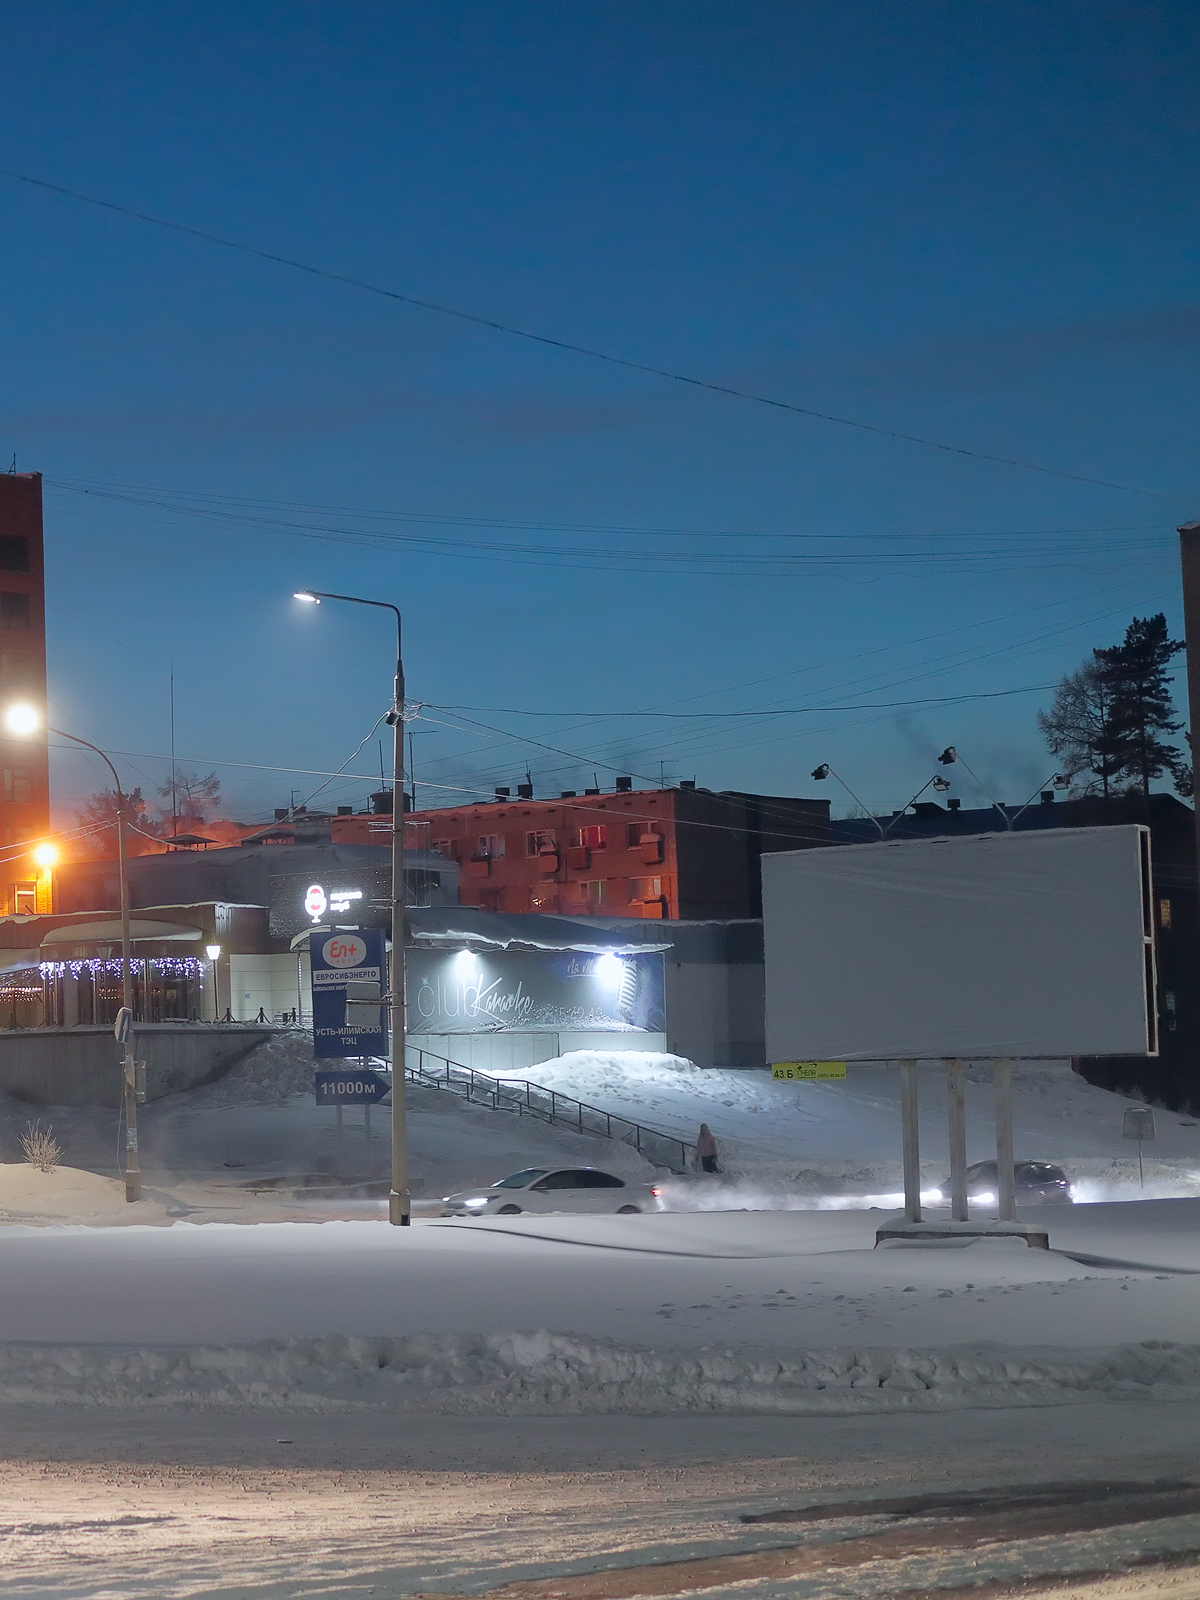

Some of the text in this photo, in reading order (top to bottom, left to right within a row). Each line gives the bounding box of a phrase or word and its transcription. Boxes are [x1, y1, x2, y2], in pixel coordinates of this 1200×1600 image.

[316, 970, 377, 981] ЕВРОСИБЭНЕРГО
[417, 975, 479, 1017] club
[315, 1026, 382, 1036] УСТЬ-ИЛИМСКАЯ
[341, 1037, 357, 1045] ТЭЦ
[774, 1069, 784, 1079] 43
[321, 1081, 376, 1095] 11000м
